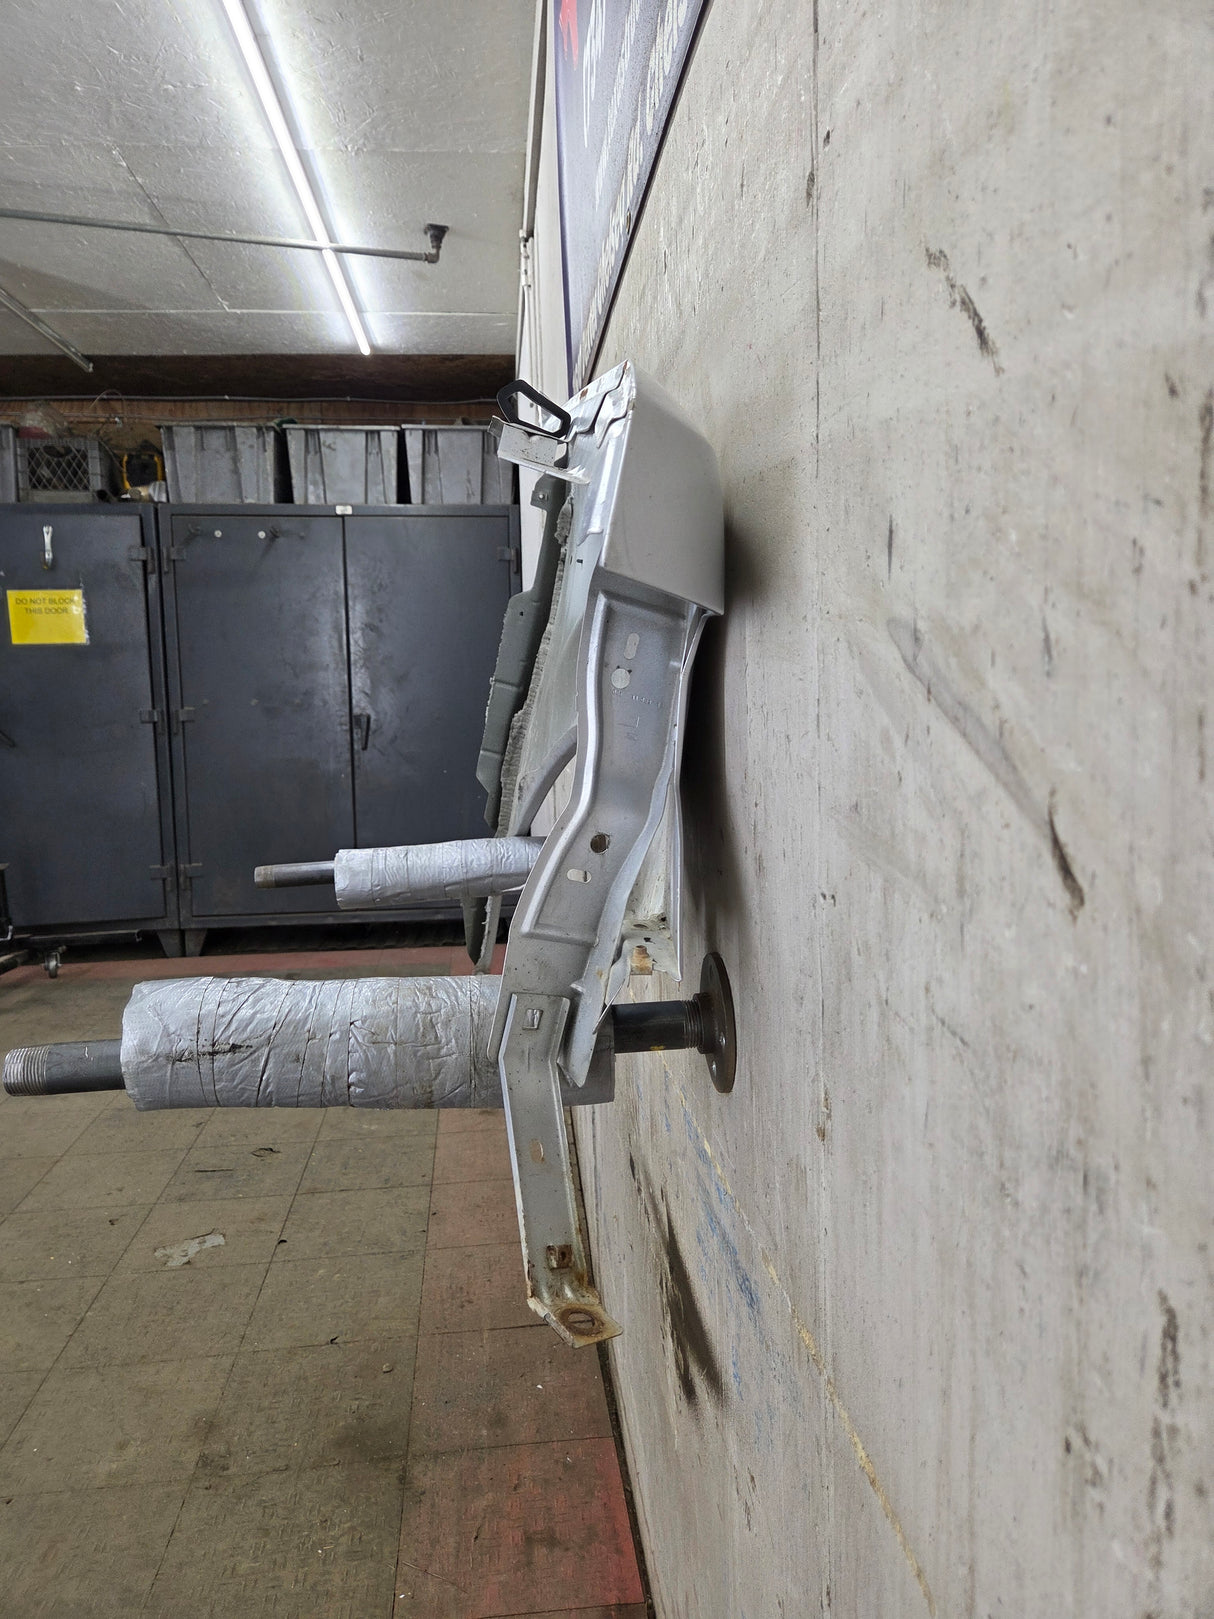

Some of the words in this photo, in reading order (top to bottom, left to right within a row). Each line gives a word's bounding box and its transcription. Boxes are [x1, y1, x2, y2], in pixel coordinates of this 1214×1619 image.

[15, 597, 28, 605] DO
[29, 597, 46, 605] NOT
[48, 597, 76, 605] BLOCK
[25, 607, 43, 615] THIS
[44, 607, 69, 615] DOOR
